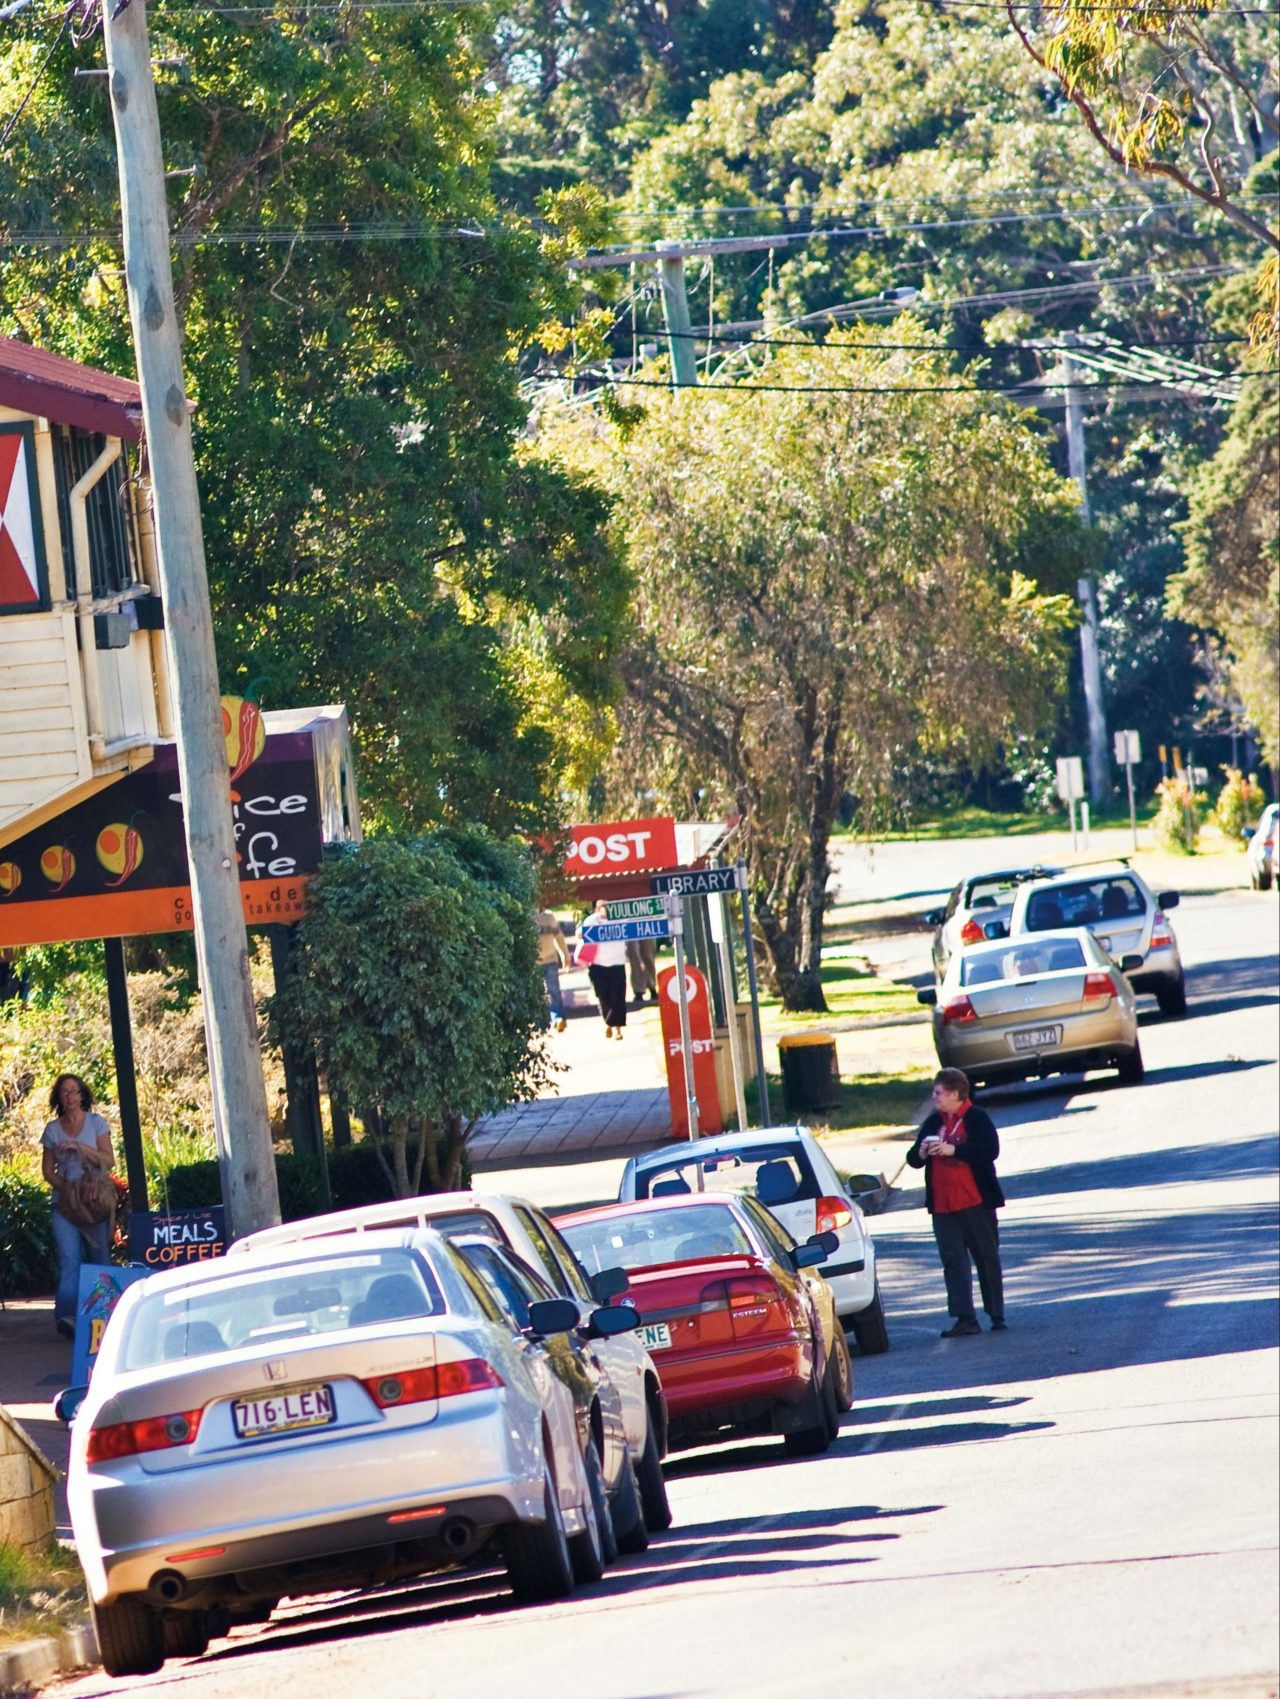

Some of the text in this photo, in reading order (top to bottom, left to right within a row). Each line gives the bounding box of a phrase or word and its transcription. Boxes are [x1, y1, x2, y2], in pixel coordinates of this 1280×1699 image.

[656, 872, 731, 895] LIBRARY
[606, 900, 654, 919] YUULONG
[597, 920, 664, 941] GUIDE HALL
[669, 1040, 712, 1056] PST
[153, 1221, 218, 1245] MEALS
[145, 1242, 224, 1264] COFFEE
